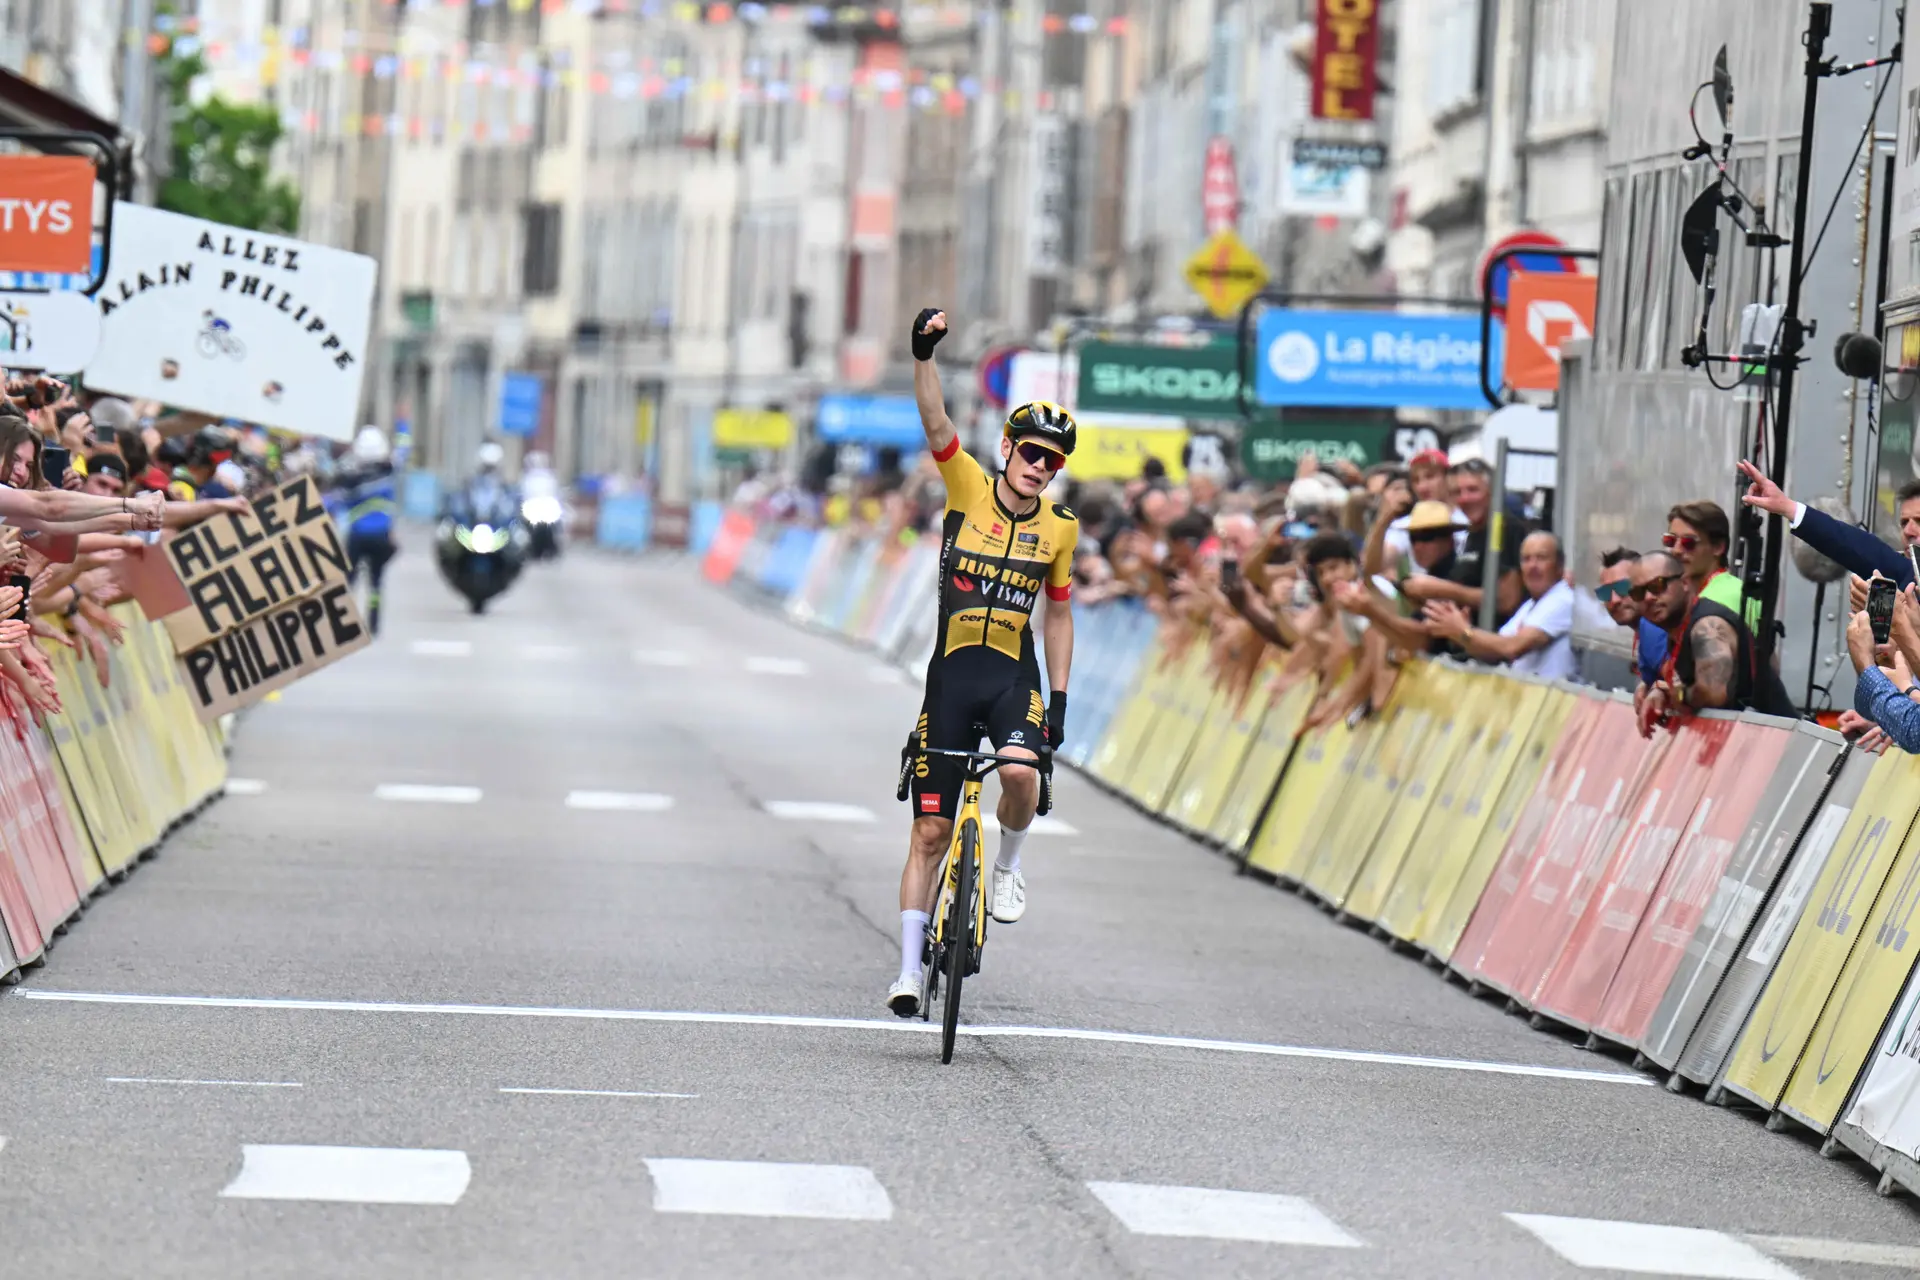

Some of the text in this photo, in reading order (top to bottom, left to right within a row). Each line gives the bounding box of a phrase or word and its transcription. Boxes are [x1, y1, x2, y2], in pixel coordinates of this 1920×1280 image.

[197, 231, 301, 272] ALLEZ
[101, 261, 356, 371] ALAIN PHILIPPE
[1325, 331, 1367, 363] La
[169, 478, 325, 578] ALLEZ
[955, 556, 1040, 593] JUMBO
[981, 580, 1033, 610] VISMA
[185, 586, 361, 707] PHILIPPE
